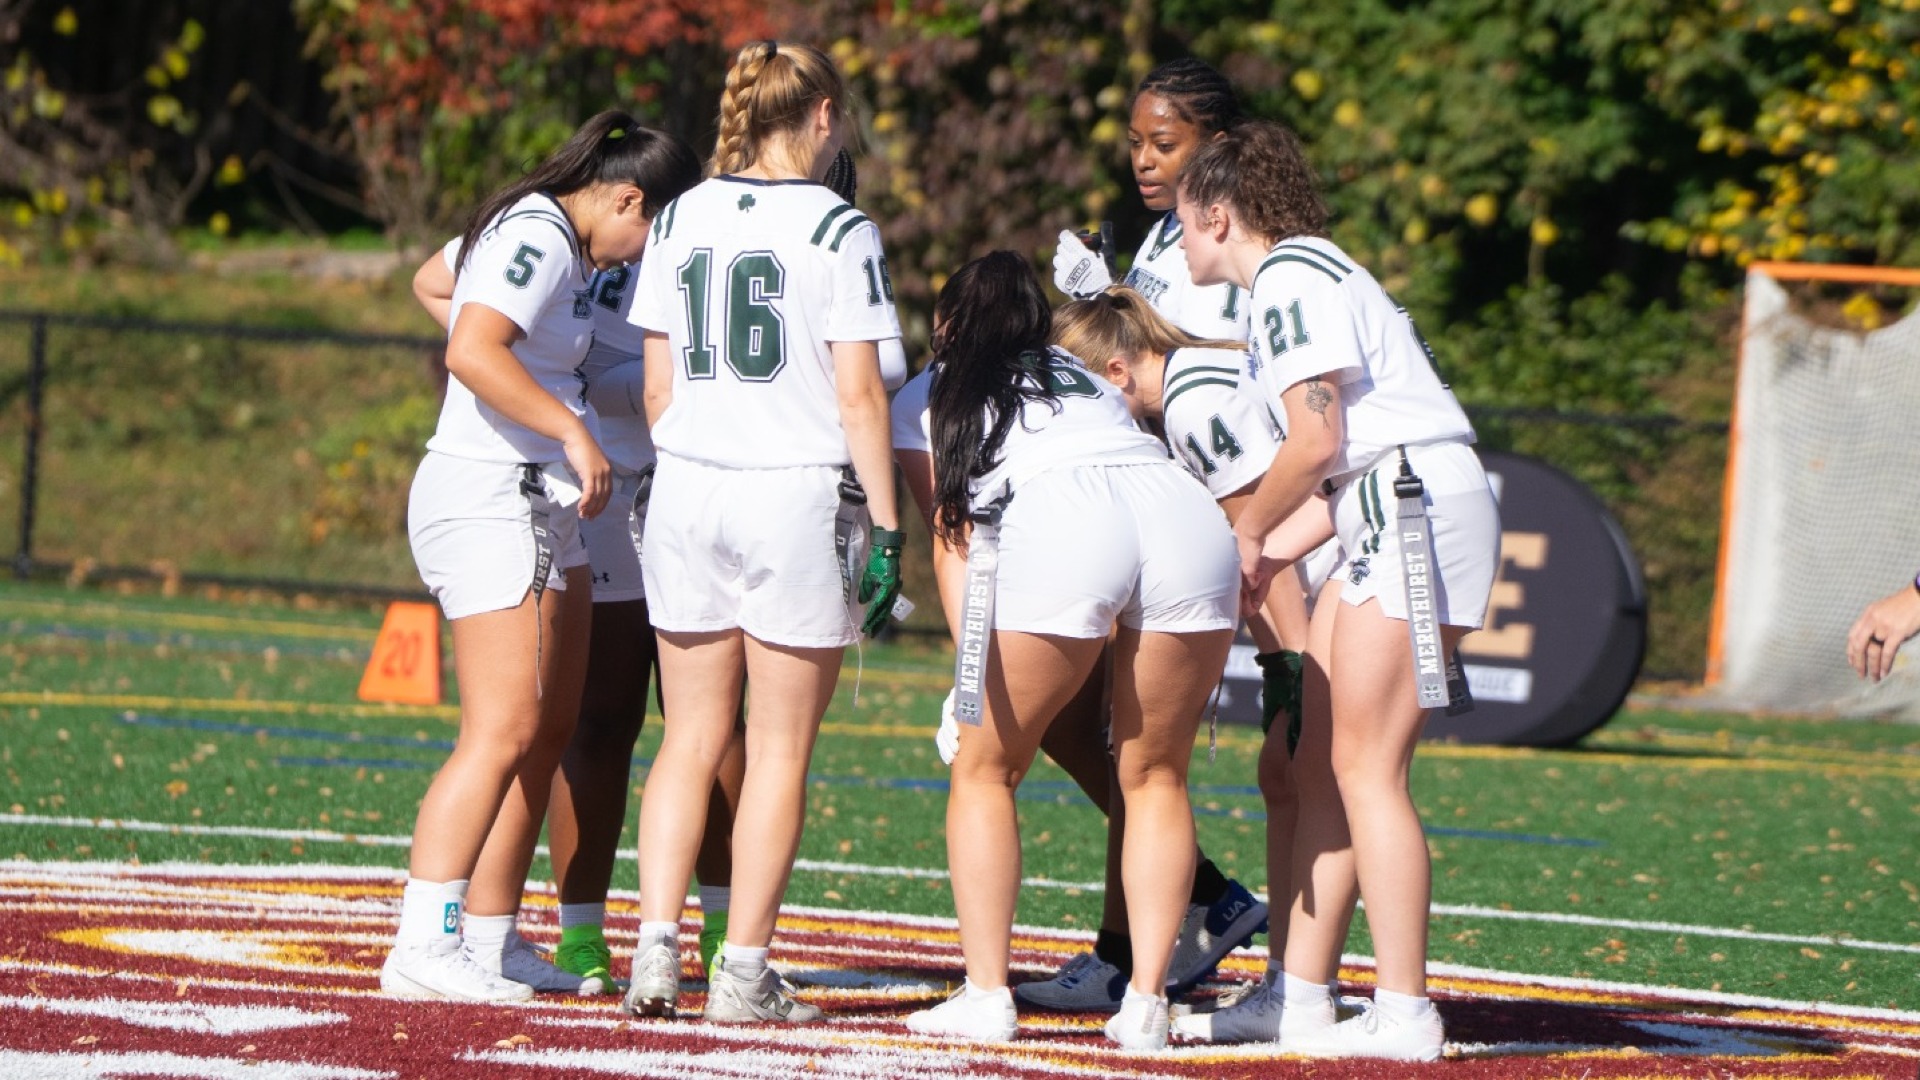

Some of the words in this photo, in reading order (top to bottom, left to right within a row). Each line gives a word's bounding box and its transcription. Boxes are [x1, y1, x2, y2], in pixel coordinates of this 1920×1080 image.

[503, 241, 546, 289] 5
[677, 247, 787, 383] 16
[1264, 297, 1311, 360] 21
[1185, 413, 1244, 476] 14
[1403, 531, 1422, 543] U
[961, 571, 990, 694] MERCYHURST
[1406, 552, 1439, 675] MERCYHURST
[380, 628, 424, 679] 20
[1222, 901, 1247, 921] UA
